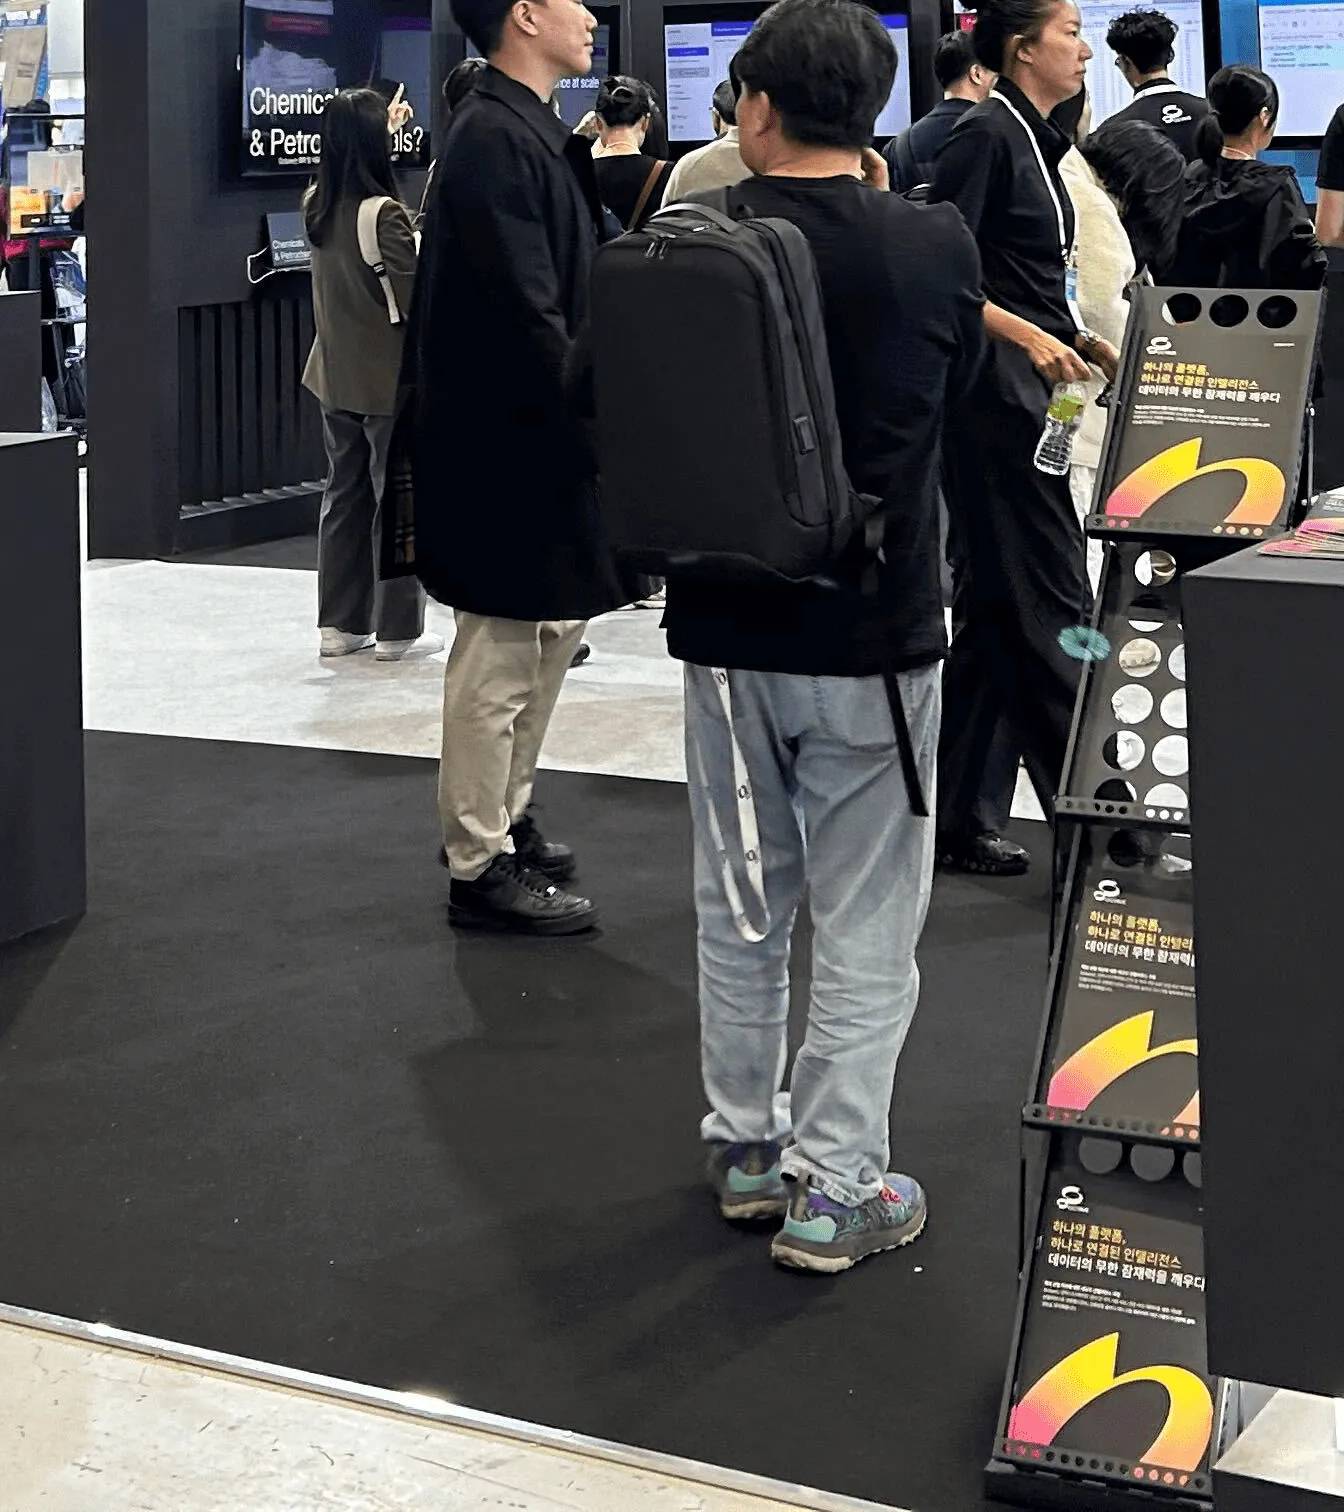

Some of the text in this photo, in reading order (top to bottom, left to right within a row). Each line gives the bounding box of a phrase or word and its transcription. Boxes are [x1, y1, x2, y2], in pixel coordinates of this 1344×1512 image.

[249, 129, 265, 157] &
[1138, 384, 1179, 397] 데이터의
[1181, 386, 1203, 399] 무한
[1089, 910, 1123, 928] 하나의
[1088, 925, 1121, 942] 하나로
[1085, 940, 1129, 958] 데이터의
[1132, 946, 1155, 962] 무한
[1052, 1220, 1127, 1244] 하나의 플랫폼,
[1050, 1236, 1183, 1269] 하나로 연결된 인텔리전스
[1047, 1252, 1093, 1272] 데이터의
[1095, 1259, 1119, 1277] 무한
[1121, 1262, 1167, 1286] 잠재력을
